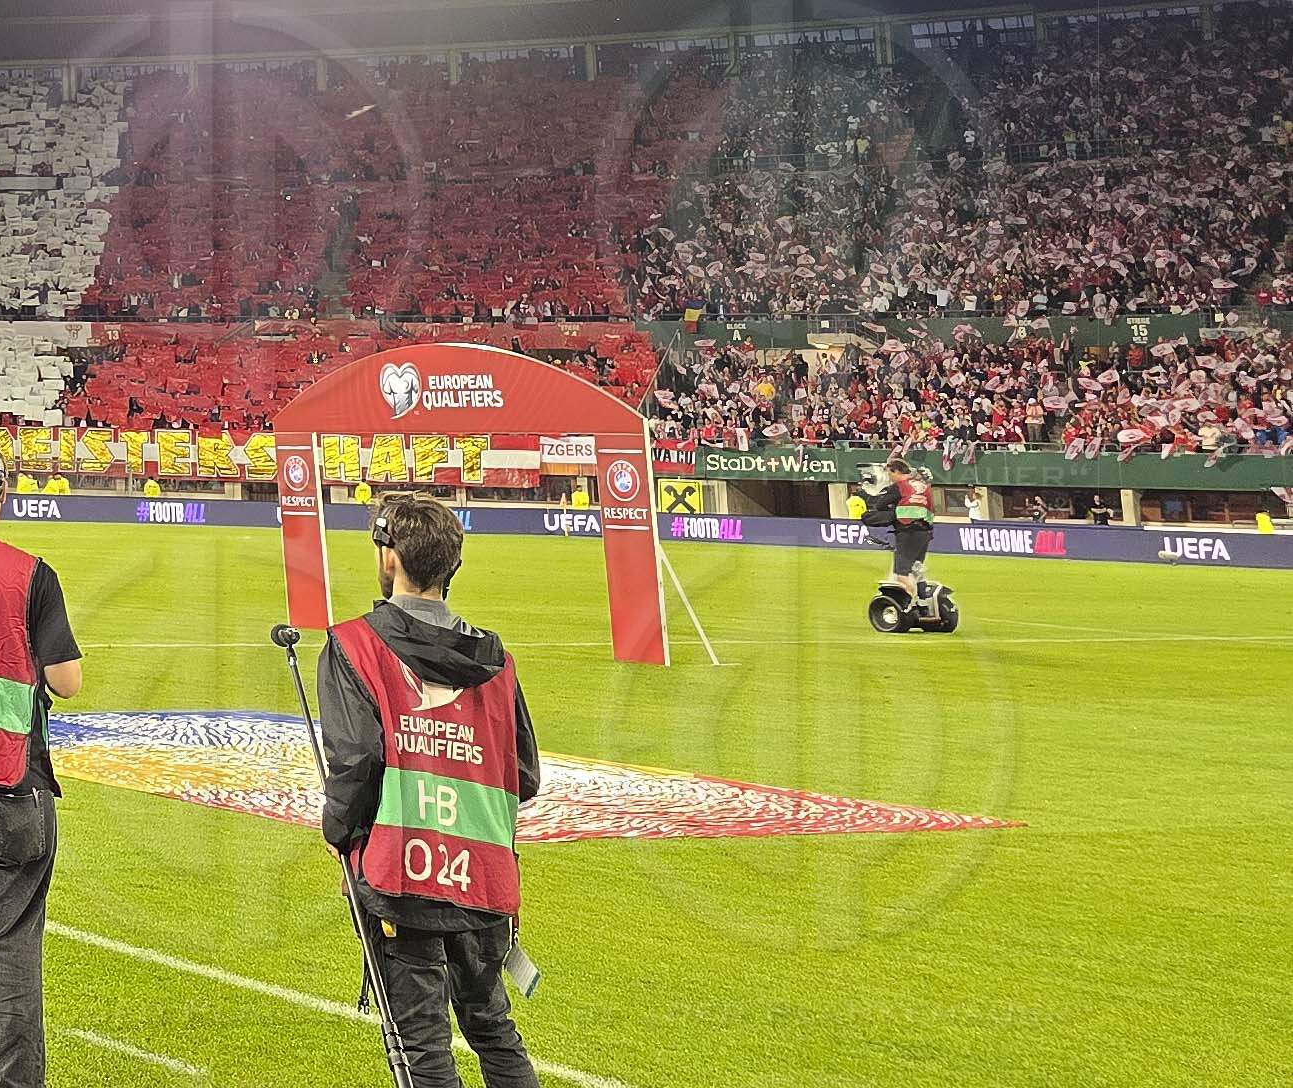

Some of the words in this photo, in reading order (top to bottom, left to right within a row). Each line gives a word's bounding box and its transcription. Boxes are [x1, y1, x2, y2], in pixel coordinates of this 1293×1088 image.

[1131, 325, 1149, 336] 15
[428, 374, 494, 390] EUROPEAN
[422, 390, 504, 410] QUALIFIERS
[13, 499, 61, 519] UEFA
[137, 501, 206, 523] #FOOTBALL
[282, 496, 315, 507] RESPECT
[543, 513, 601, 532] UEFA
[604, 507, 648, 520] RESPECT
[670, 517, 743, 540] #FOOTBALL
[959, 528, 1034, 553] WELCOME
[1034, 530, 1067, 556] ALL
[1164, 537, 1231, 561] UEFA
[400, 715, 474, 743] EUROPEAN
[394, 732, 483, 765] QUALIFIERS
[418, 780, 458, 826] HB
